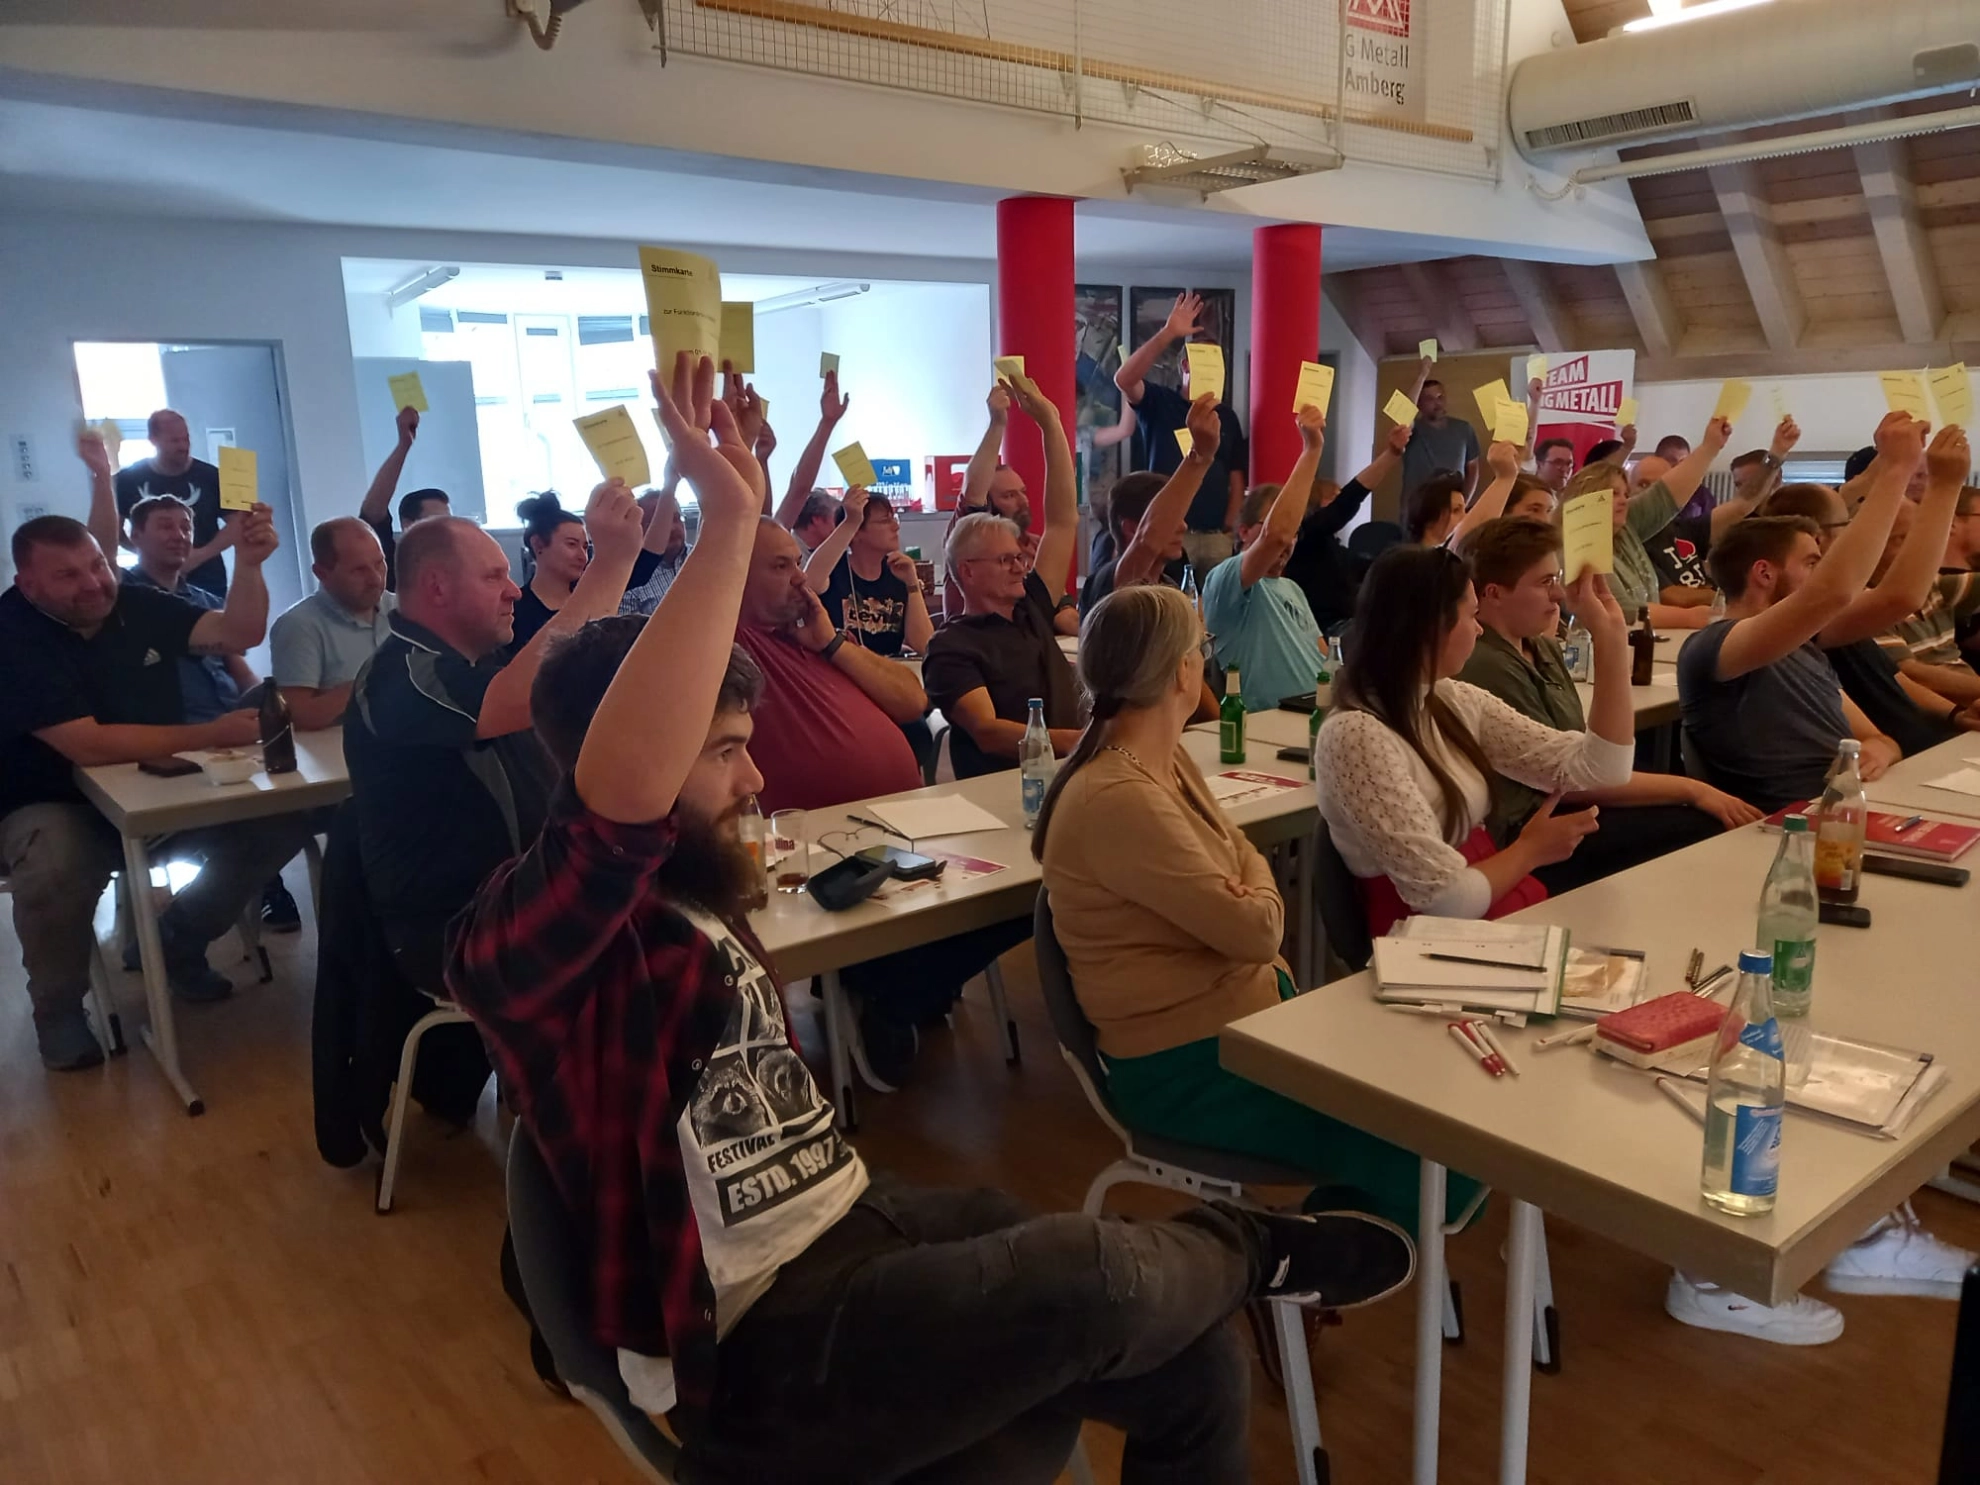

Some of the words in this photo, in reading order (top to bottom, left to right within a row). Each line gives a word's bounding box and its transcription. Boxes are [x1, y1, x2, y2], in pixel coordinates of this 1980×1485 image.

[1344, 34, 1355, 58] G
[1361, 38, 1409, 69] Metall
[1344, 66, 1405, 105] Amberg
[650, 264, 694, 277] Stimmkarte
[1555, 384, 1618, 413] METALL
[706, 1133, 777, 1173] FESTIVAL
[726, 1163, 798, 1214] ESTD.
[789, 1135, 836, 1180] 1997
